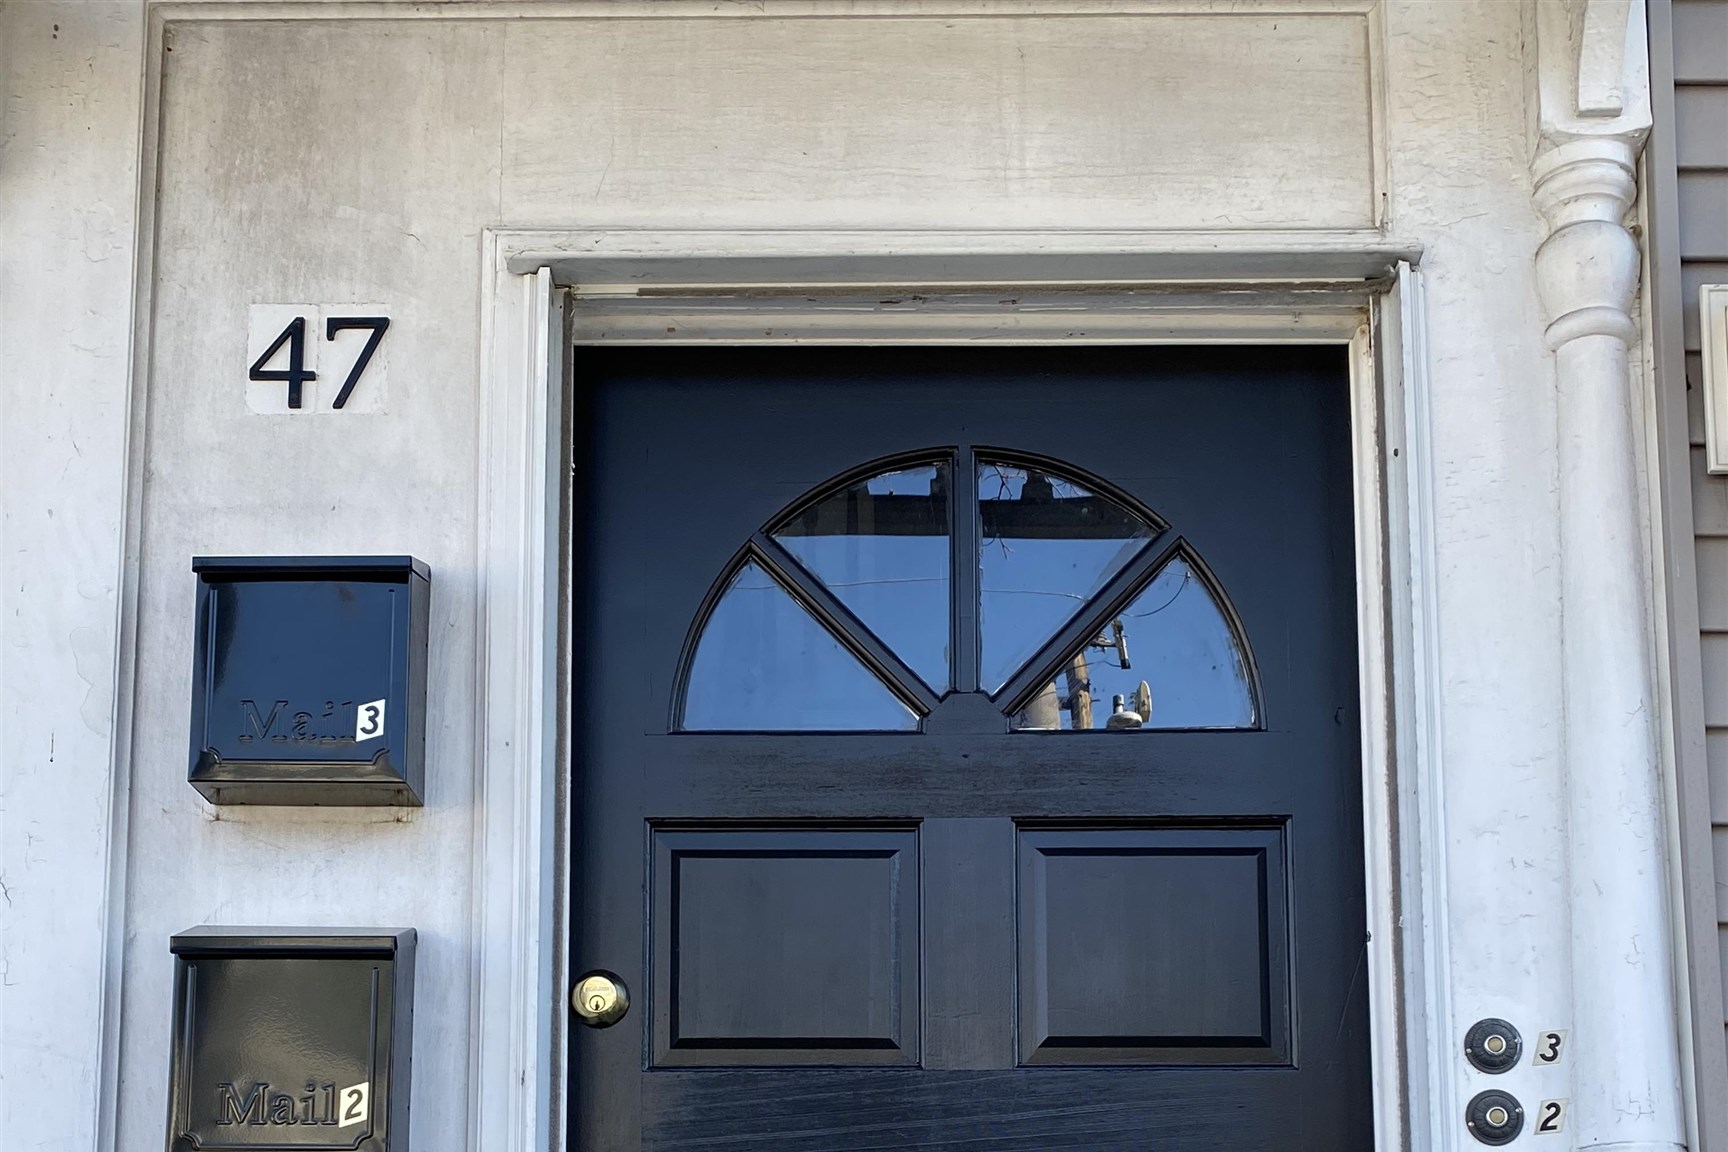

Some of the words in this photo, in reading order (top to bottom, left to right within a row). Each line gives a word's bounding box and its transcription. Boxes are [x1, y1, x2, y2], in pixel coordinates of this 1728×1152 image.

[249, 316, 391, 409] 47
[238, 700, 355, 742] Mail
[359, 705, 380, 735] 3
[1539, 1033, 1561, 1062] 3
[216, 1082, 338, 1126] Mail
[344, 1089, 363, 1121] 2
[1540, 1102, 1561, 1131] 2
